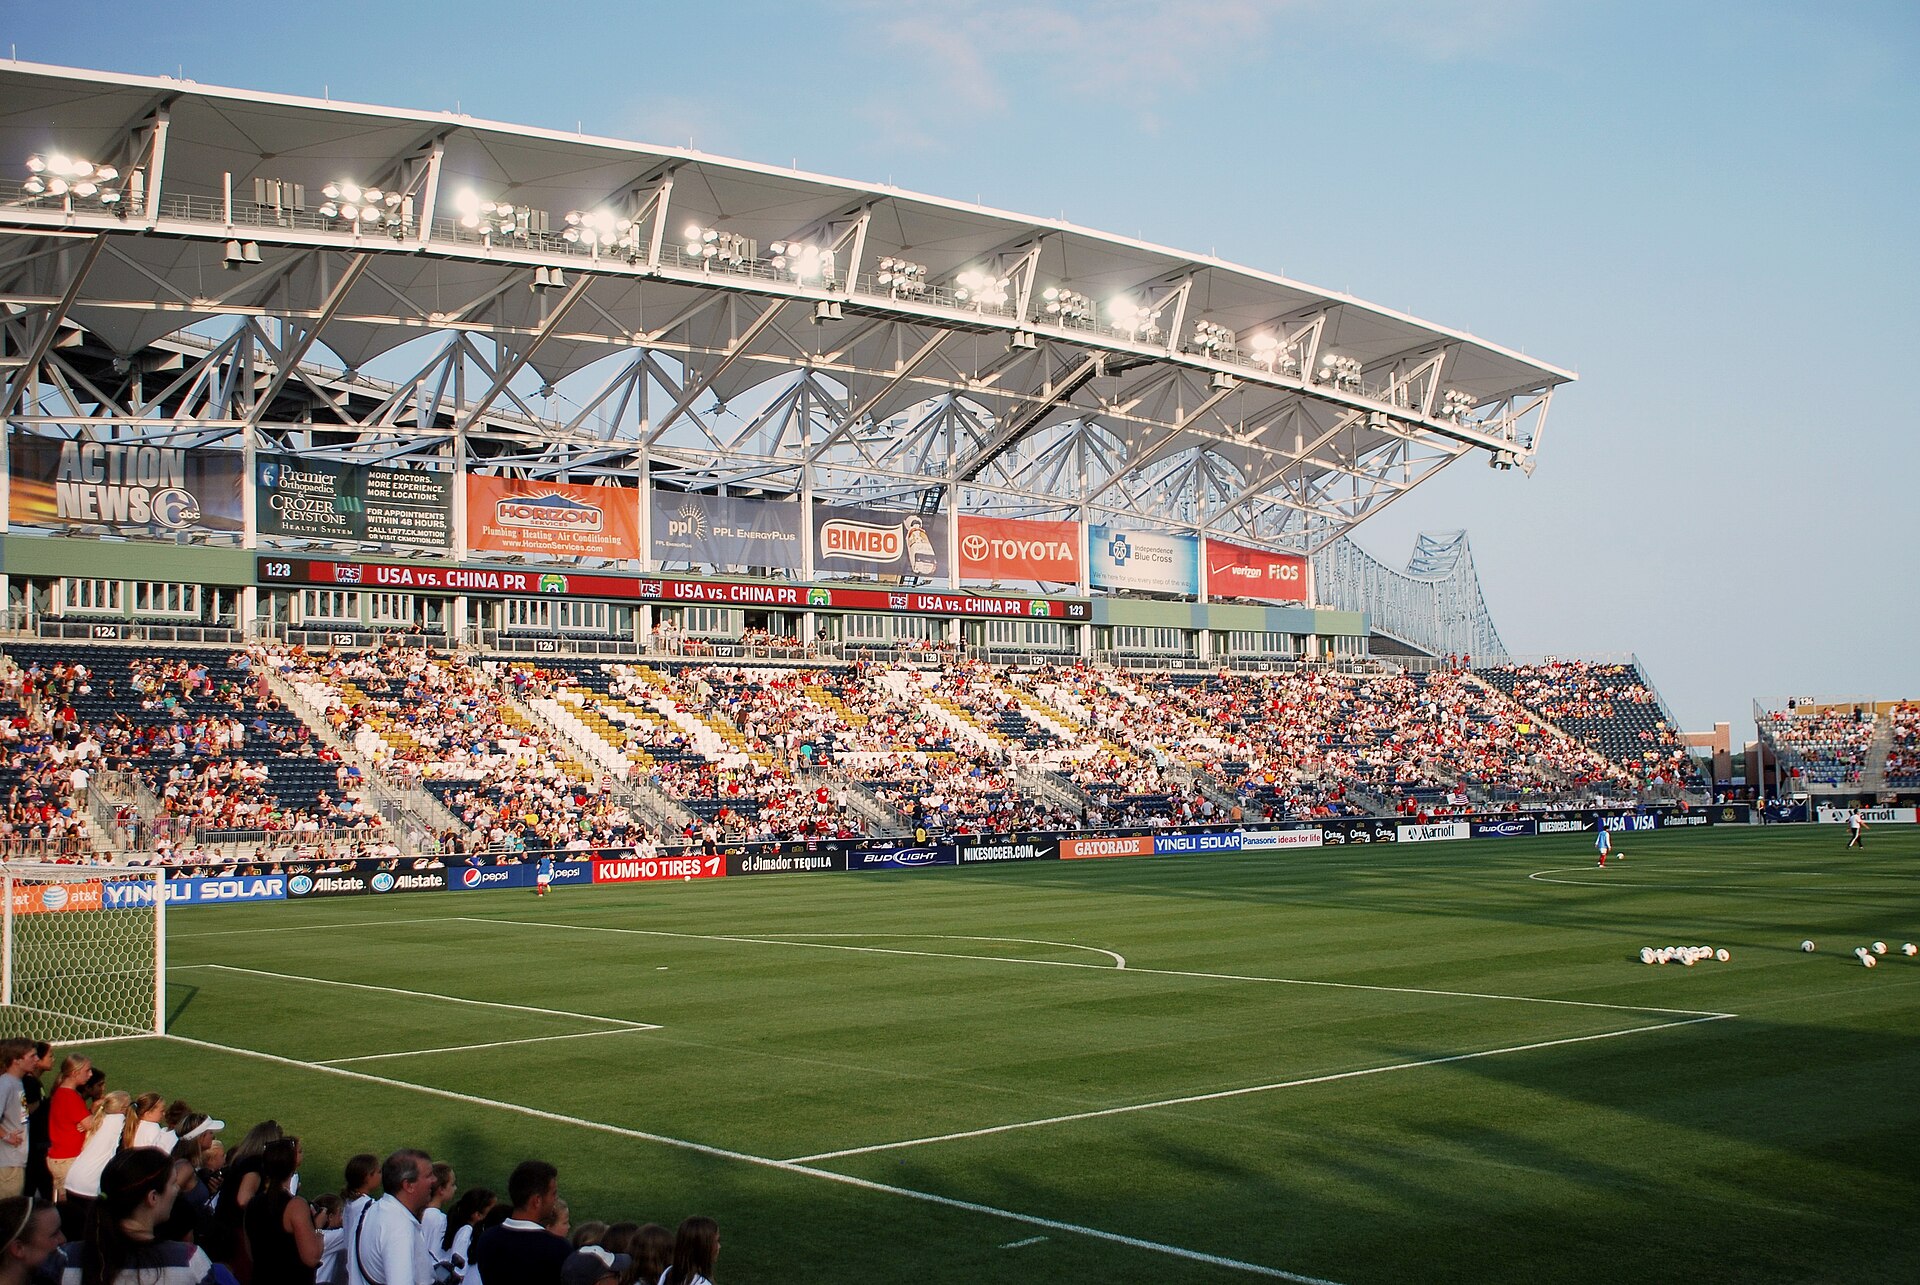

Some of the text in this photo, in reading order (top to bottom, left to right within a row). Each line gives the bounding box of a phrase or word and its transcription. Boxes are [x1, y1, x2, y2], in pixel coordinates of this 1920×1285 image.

[57, 440, 185, 488] ACTION
[280, 464, 336, 485] Premier
[369, 472, 432, 484] MORE DOCTORS.
[280, 479, 334, 494] Orthopaedics
[368, 480, 445, 493] MORE EXPERIENCE.
[368, 488, 440, 501] MORE LOCATIONS.
[56, 482, 150, 523] NEWS
[270, 494, 334, 514] CROZER
[179, 510, 200, 520] abc
[282, 509, 346, 525] KEYSTONE
[367, 508, 444, 520] FOR APPOINTMENTS
[368, 516, 398, 525] WITHIN
[400, 518, 412, 526] 48
[500, 505, 598, 524] HORIZON
[668, 516, 692, 536] ppl
[713, 527, 734, 537] PPL
[483, 526, 622, 545] Plumbing Heating Air Conditioning
[827, 528, 898, 554] BIMBO
[502, 540, 603, 552] www.HorizonServices.com
[991, 540, 1074, 560] TOYOTA
[1134, 545, 1174, 554] Independence
[1134, 553, 1172, 564] Blue Cross
[266, 562, 291, 578] 1:23
[1232, 566, 1262, 578] verizon
[1268, 564, 1298, 580] FiOS
[377, 567, 526, 590] USA vs. CHINA PR
[674, 583, 797, 602] USA vs. CHINA PR
[918, 596, 1021, 614] USA vs. CHINA PR
[1068, 604, 1084, 616] 1:23
[95, 626, 116, 638] 124
[334, 634, 352, 644] 125
[538, 642, 554, 652] 126
[718, 647, 732, 656] 127
[1860, 808, 1896, 820] arriott
[1478, 824, 1524, 832] BUD LIGHT
[1603, 817, 1626, 831] VISA
[1632, 816, 1654, 830] VISA
[1418, 825, 1454, 840] Marriott
[1156, 834, 1240, 850] YINGLI SOLAR
[1243, 834, 1320, 846] Panasonic ideas for life
[964, 844, 1034, 861] NIKESOCCER.COM
[1075, 840, 1140, 856] GATORADE
[742, 856, 752, 871] el
[794, 856, 832, 870] TEQUILA
[864, 852, 938, 863] BUD LIGHT
[482, 870, 508, 882] pepsi
[555, 867, 580, 879] pepsi
[600, 859, 700, 879] KUMHO TIRES
[312, 876, 366, 892] Allstate.
[394, 872, 446, 888] Allstate.
[201, 878, 283, 898] SOLAR
[71, 890, 98, 902] at&t
